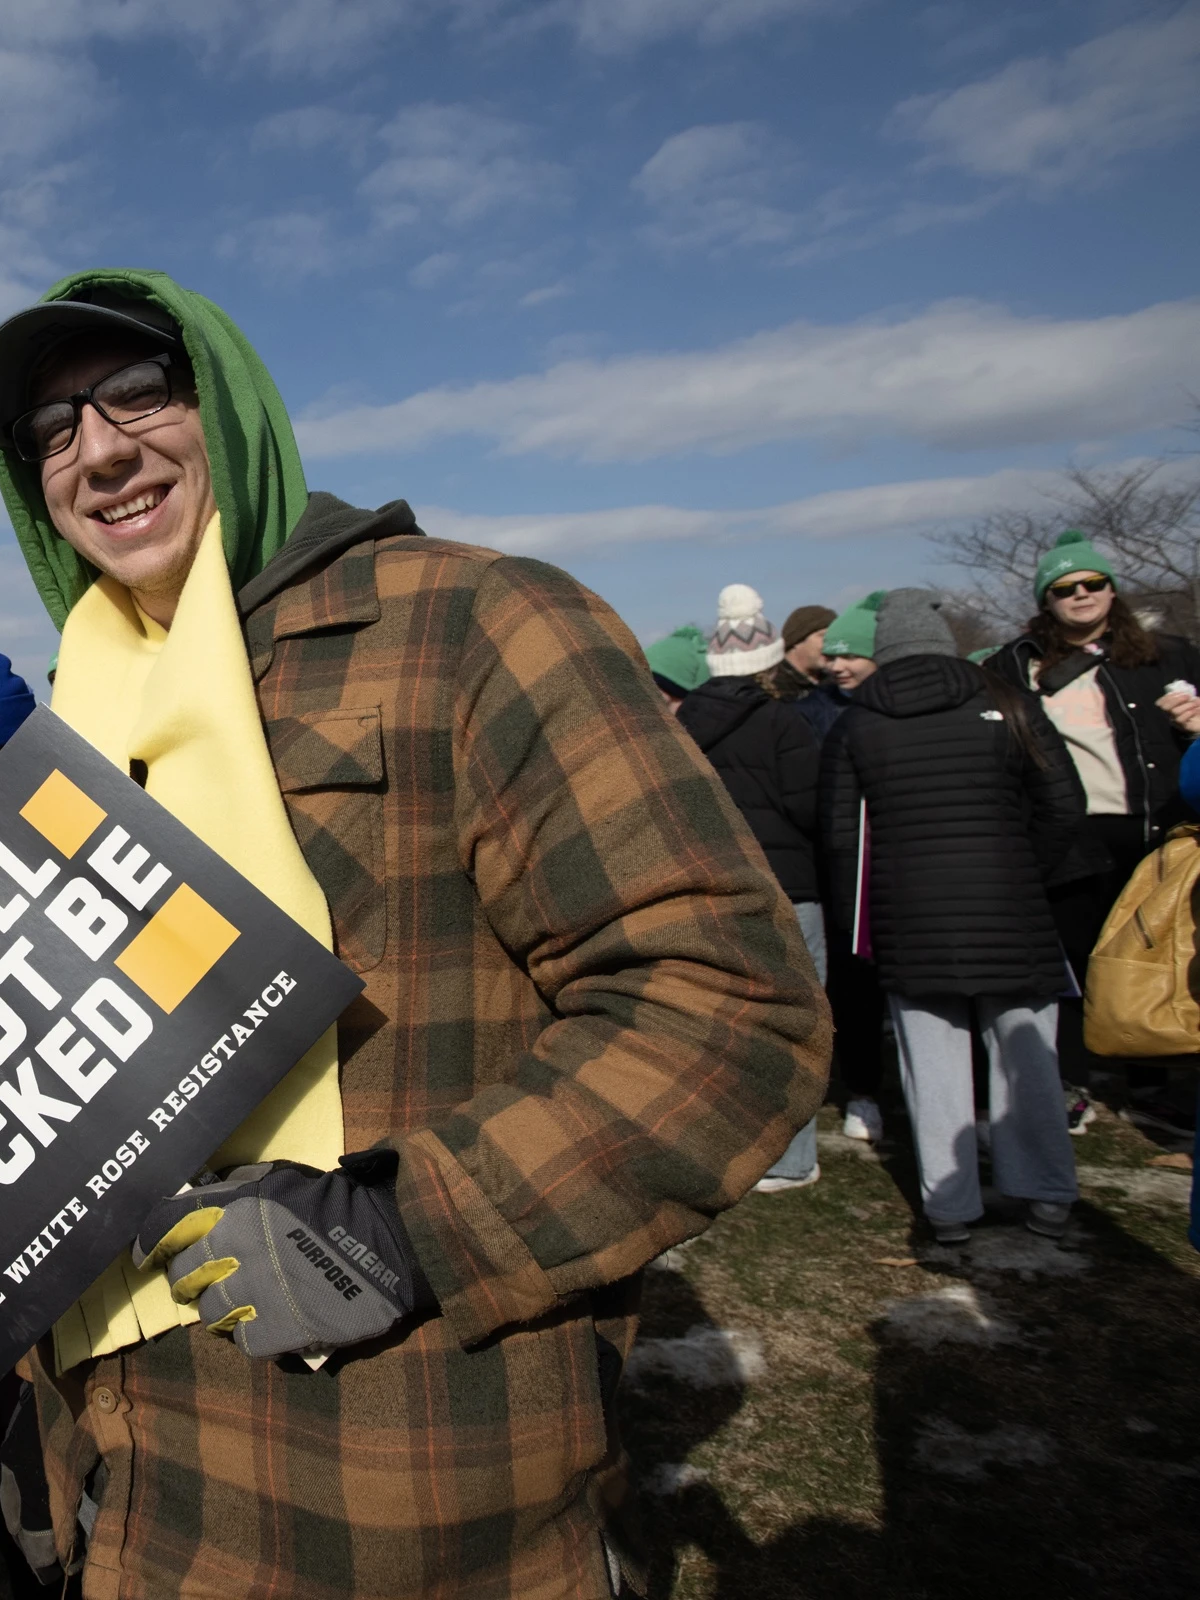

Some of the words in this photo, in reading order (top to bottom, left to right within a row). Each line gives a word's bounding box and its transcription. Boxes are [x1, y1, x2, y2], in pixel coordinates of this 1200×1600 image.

[43, 824, 173, 962] BE
[3, 1196, 89, 1284] WHITE
[85, 1130, 151, 1200] ROSE
[147, 970, 297, 1133] RESISTANCE
[286, 1227, 363, 1302] PURPOSE
[327, 1225, 400, 1295] GENERAL
